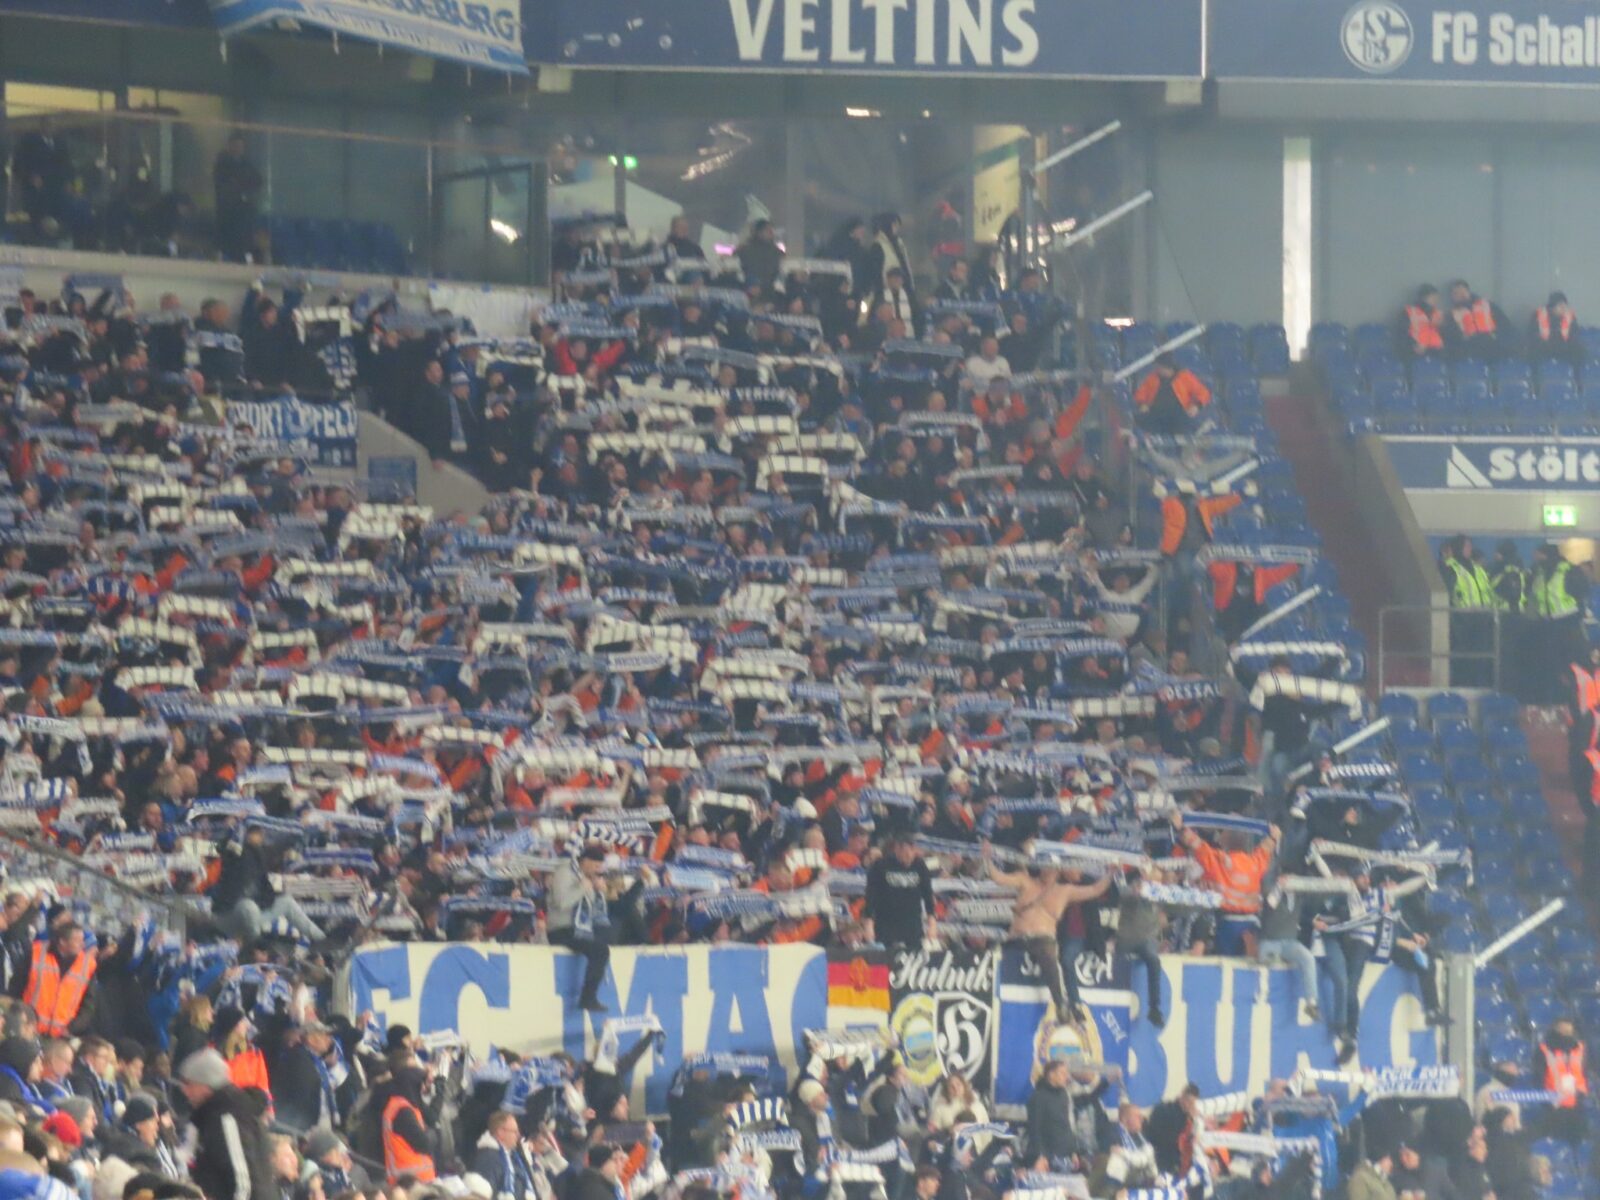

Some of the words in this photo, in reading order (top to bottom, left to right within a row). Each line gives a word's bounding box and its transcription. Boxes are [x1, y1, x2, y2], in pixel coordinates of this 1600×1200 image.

[730, 0, 1039, 67] VELTINS
[1432, 11, 1478, 65] FC
[1489, 12, 1600, 67] Schal
[1489, 446, 1600, 482] Stölt
